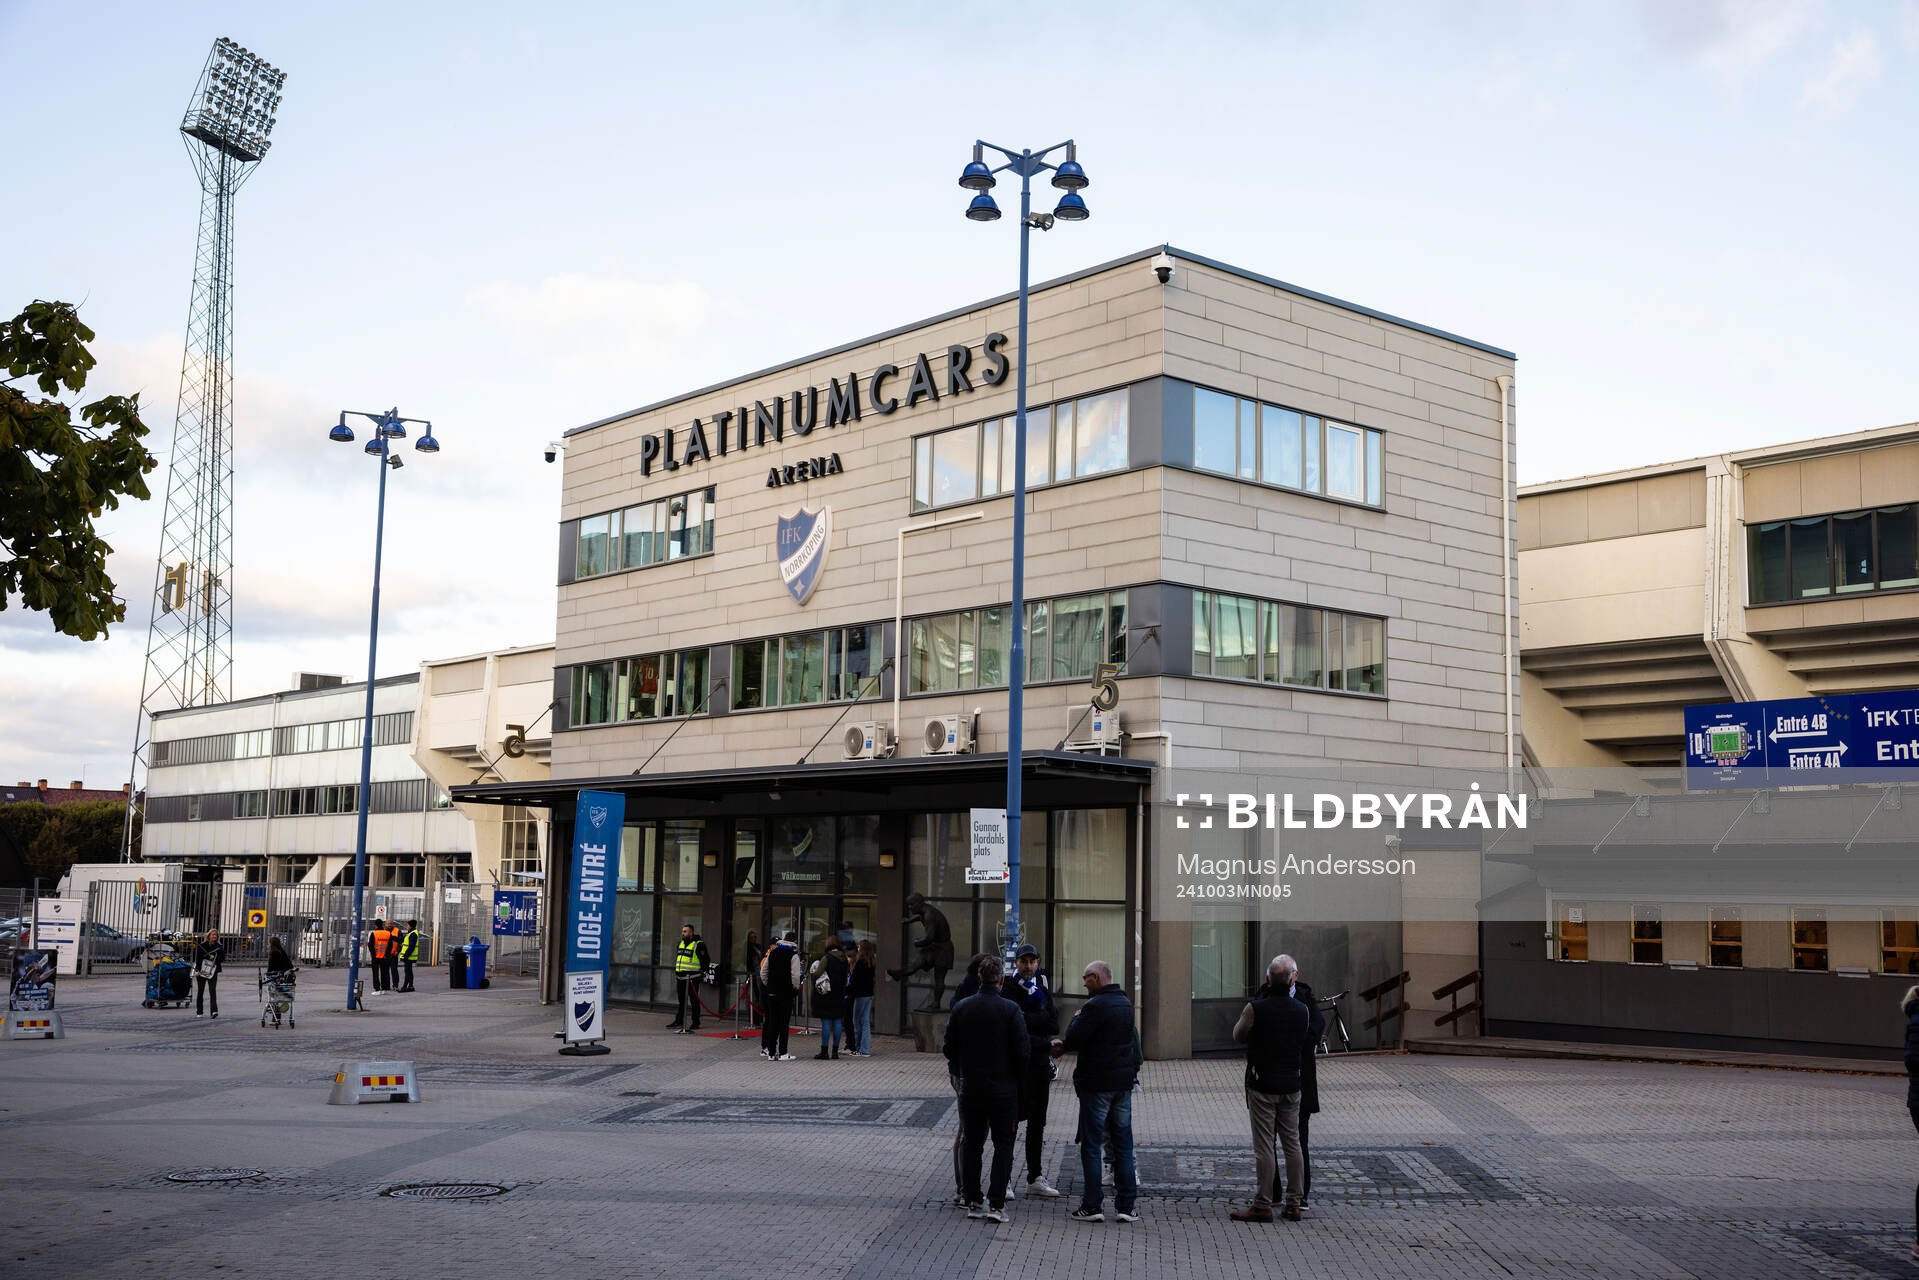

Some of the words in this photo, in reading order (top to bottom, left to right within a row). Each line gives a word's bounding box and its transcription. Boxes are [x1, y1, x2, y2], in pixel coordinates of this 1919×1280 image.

[640, 332, 1010, 476] PLATINUMCARS
[766, 452, 844, 489] ARENA
[781, 526, 802, 545] IFK
[784, 524, 825, 577] NORRKÖPING
[1091, 662, 1120, 712] 5
[1777, 715, 1809, 733] Entré
[1811, 713, 1828, 730] 4B
[1789, 753, 1822, 770] Entré
[1824, 752, 1841, 769] 4A
[973, 820, 1000, 832] Gunnar
[973, 832, 1005, 845] Nordahls
[973, 844, 991, 858] plats
[781, 871, 821, 881] Välkommen
[139, 895, 158, 915] NEP
[576, 842, 607, 960] LOGE-ENTRÉ
